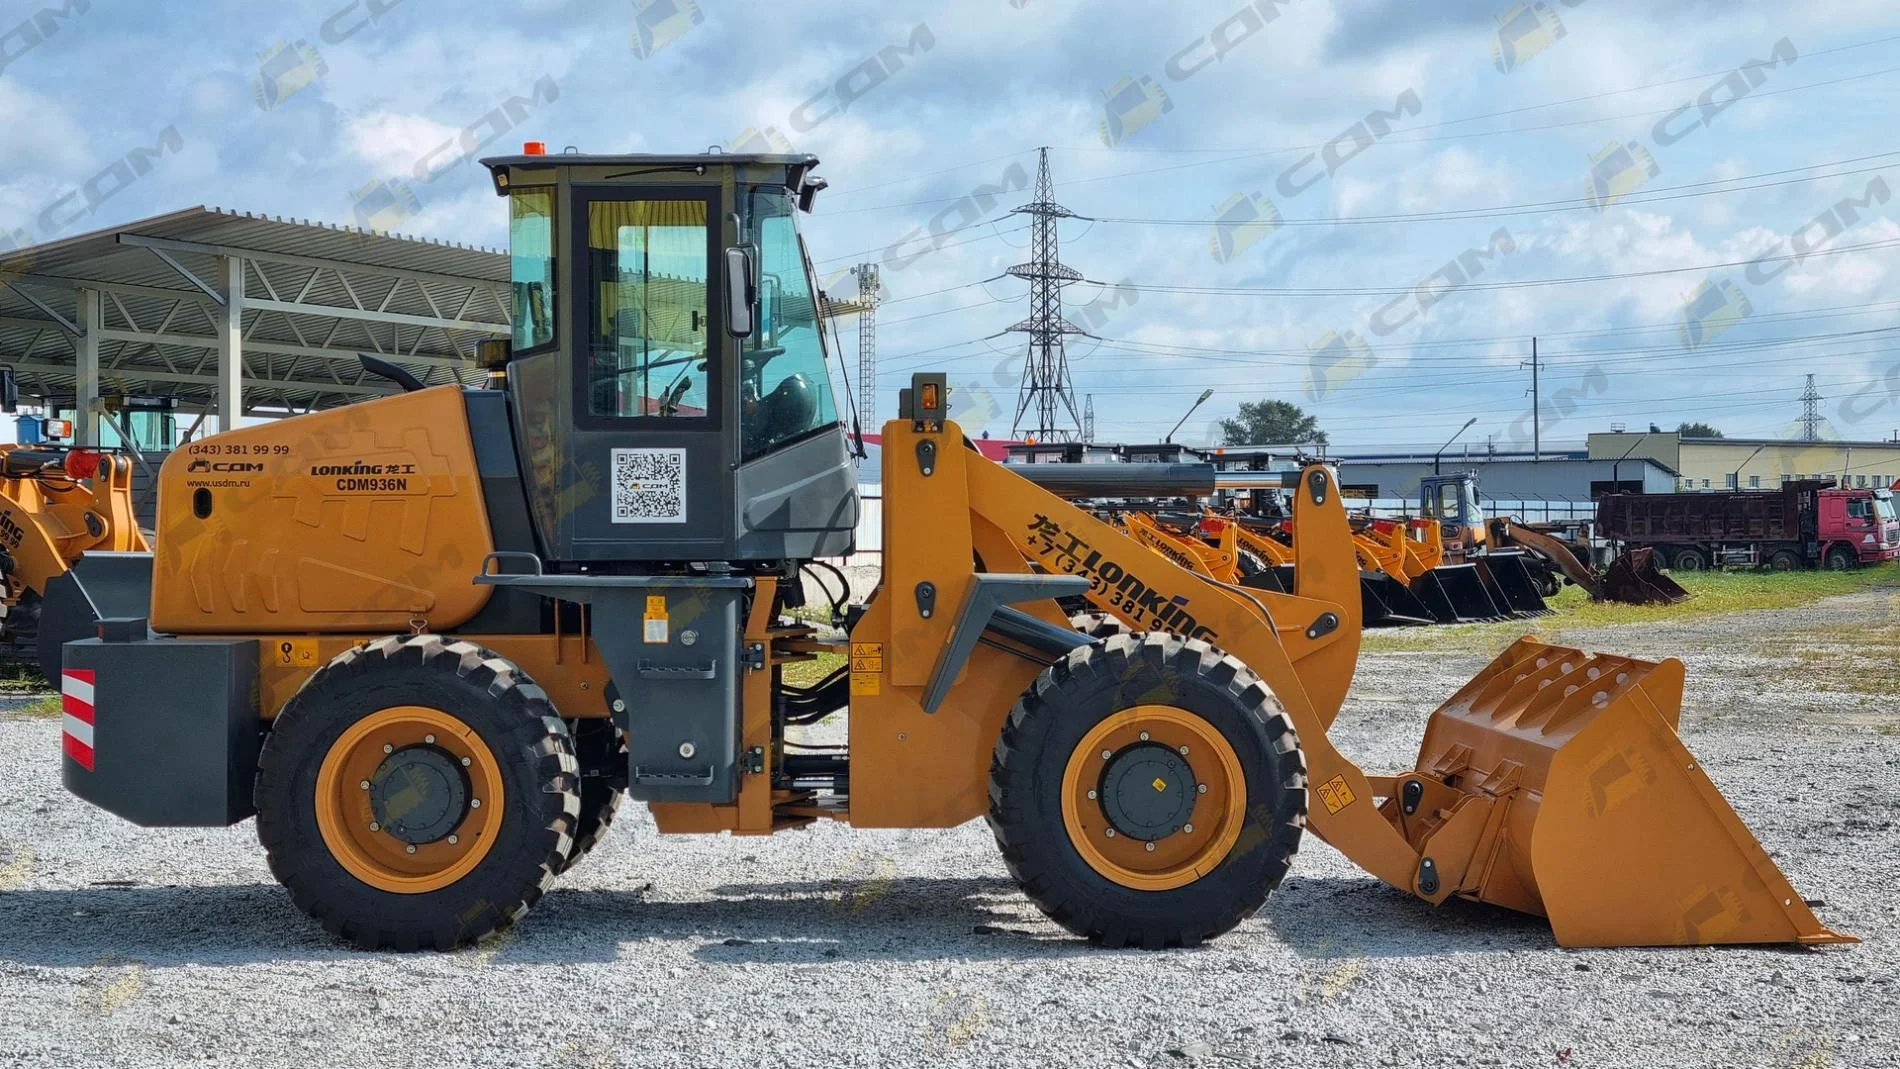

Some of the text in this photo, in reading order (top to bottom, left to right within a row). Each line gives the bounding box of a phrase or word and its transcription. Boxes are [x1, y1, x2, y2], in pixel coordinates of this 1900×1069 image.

[188, 444, 290, 456] (343) 381 99 99
[187, 480, 250, 488] www.usdm.ru
[336, 478, 407, 491] CDM936N
